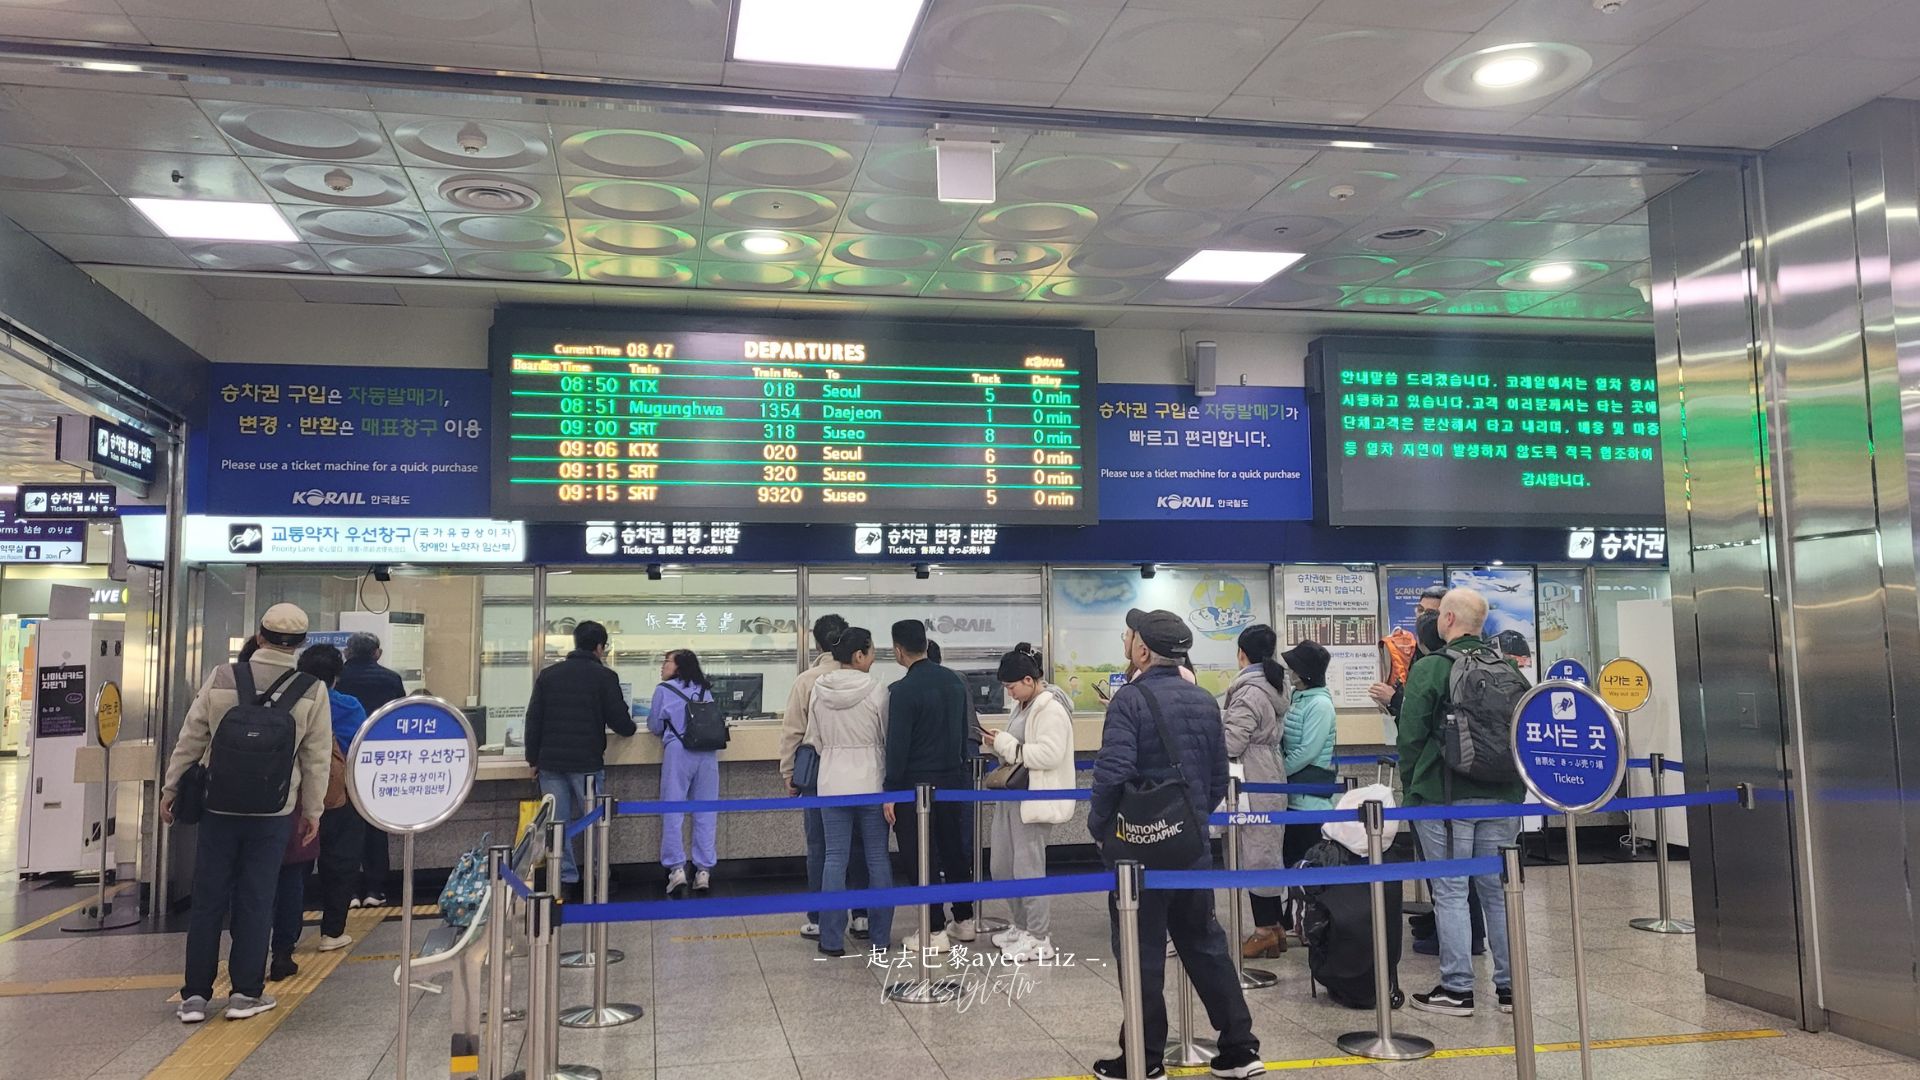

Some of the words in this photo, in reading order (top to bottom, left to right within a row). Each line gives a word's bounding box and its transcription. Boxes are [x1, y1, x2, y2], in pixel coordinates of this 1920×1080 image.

[554, 343, 594, 355] Current
[595, 345, 621, 356] Time
[627, 342, 648, 357] 08
[653, 344, 673, 358] 47
[744, 341, 865, 361] DEPARTURES
[513, 359, 560, 371] Boarding
[561, 361, 591, 372] Time
[629, 363, 660, 375] Train
[753, 367, 781, 378] Train
[826, 369, 840, 380] To
[972, 373, 1001, 385] Track
[1031, 375, 1061, 388] Delay
[1341, 370, 1398, 386] 안내말씀
[1407, 373, 1498, 388] 드리겠습니다.
[1506, 376, 1588, 391] 코레일에서는
[1595, 378, 1622, 391] 열차
[1630, 379, 1655, 392] 정시
[220, 383, 280, 404] 승차권
[288, 385, 343, 405] 구입은
[348, 386, 450, 407] 자동발매기,
[560, 376, 618, 392] 08:50
[629, 379, 658, 393] KTX
[763, 382, 795, 397] 018
[822, 384, 861, 399] Seoul
[985, 387, 995, 402] 5
[1032, 389, 1042, 403] 0
[1046, 391, 1071, 404] min
[560, 397, 616, 414] 08:51
[629, 401, 724, 418] Mugunghwa
[759, 402, 800, 418] 1354
[822, 405, 882, 421] Daejeon
[986, 408, 993, 423] 1
[1033, 409, 1043, 423] 0
[1046, 411, 1071, 424] min
[1099, 401, 1148, 419] 승차권
[1155, 402, 1200, 419] 구입은
[1205, 403, 1299, 421] 자동발매기가
[1343, 394, 1399, 407] 시행하고
[1506, 398, 1589, 413] 여러분께서는
[1596, 400, 1623, 413] 타는
[1631, 401, 1657, 414] 곳에
[238, 415, 278, 435] 변경
[299, 417, 354, 436] 반환은
[361, 418, 438, 438] 매표창구
[444, 419, 482, 438] 이용
[560, 419, 618, 435] 09:00
[629, 422, 657, 436] SRT
[763, 423, 795, 439] 318
[822, 426, 865, 440] Suseo
[985, 429, 995, 443] 8
[1033, 430, 1043, 443] 0
[1046, 432, 1072, 444] min
[1344, 415, 1414, 431] 단체고객은
[1423, 418, 1477, 432] 분산해서
[1487, 419, 1513, 433] 타고
[1578, 421, 1604, 435] 배웅
[1612, 422, 1625, 435] 및
[1633, 422, 1660, 436] 마중
[1129, 430, 1179, 447] 빠르고
[1185, 430, 1271, 448] 편리합니다.
[559, 441, 618, 457] 09:06
[628, 442, 658, 457] KTX
[763, 444, 797, 460] 020
[822, 446, 862, 460] Seoul
[985, 448, 995, 463] 6
[1033, 449, 1044, 463] 0
[1046, 452, 1073, 464] min
[1344, 441, 1357, 456] 등
[1366, 442, 1393, 456] 열차
[1403, 443, 1442, 457] 지연이
[1453, 444, 1507, 458] 발생하지
[1516, 445, 1557, 459] 않도록
[1565, 445, 1592, 460] 적극
[1600, 446, 1653, 460] 협조하여
[221, 460, 256, 470] Please
[259, 461, 278, 470] use
[291, 460, 321, 471] ticket
[324, 460, 370, 471] machine
[373, 461, 388, 472] for
[400, 462, 428, 474] quick
[431, 463, 478, 475] purchase
[559, 462, 619, 479] 09:15
[628, 464, 657, 479] SRT
[763, 465, 797, 481] 320
[822, 467, 866, 481] Suseo
[986, 469, 997, 484] 5
[1034, 470, 1044, 484] 0
[1047, 472, 1073, 484] min
[1101, 469, 1128, 478] Please
[1130, 470, 1144, 478] use
[1154, 469, 1177, 479] ticket
[1180, 469, 1216, 479] machine
[1218, 469, 1229, 479] for
[1239, 469, 1261, 481] quick
[1264, 470, 1301, 481] purchase
[1522, 473, 1590, 487] 감사합니다.
[51, 492, 83, 504] 승차권
[88, 492, 109, 504] 사는
[292, 489, 366, 506] KORAIL
[371, 495, 410, 505] 한국철도
[559, 485, 619, 501] 09:15
[628, 486, 658, 500] SRT
[757, 487, 802, 503] 9320
[822, 489, 866, 502] Suseo
[986, 490, 997, 504] 5
[1035, 491, 1045, 504] 0
[1047, 493, 1073, 505] min
[1157, 494, 1214, 509] KORAIL
[24, 526, 41, 534] 站台
[48, 526, 73, 534] のりば
[272, 526, 340, 543] 교통약자
[345, 527, 411, 543] 우선창구
[621, 528, 666, 544] 승차권
[888, 529, 928, 545] 승차권
[271, 545, 297, 553] Priority
[622, 546, 653, 555] Tickets
[888, 546, 916, 554] Tickets
[1601, 532, 1666, 559] 승차권
[1297, 574, 1333, 584] 승차권에는
[1304, 585, 1332, 595] 표시되지
[1394, 587, 1414, 595] SCAN
[42, 681, 67, 689] 자판기
[1604, 675, 1630, 686] 나가는
[1635, 675, 1644, 687] 곳
[396, 718, 437, 734] 대기선
[1526, 722, 1578, 749] 표사는
[1588, 725, 1606, 751] 곳
[360, 749, 412, 766] 교통약자
[418, 748, 466, 764] 우선창구
[1552, 772, 1585, 785] Tickets
[1125, 819, 1169, 835] NATIONAL
[1229, 813, 1271, 825] KORAIL
[1125, 824, 1183, 844] GEOGRAPHIC
